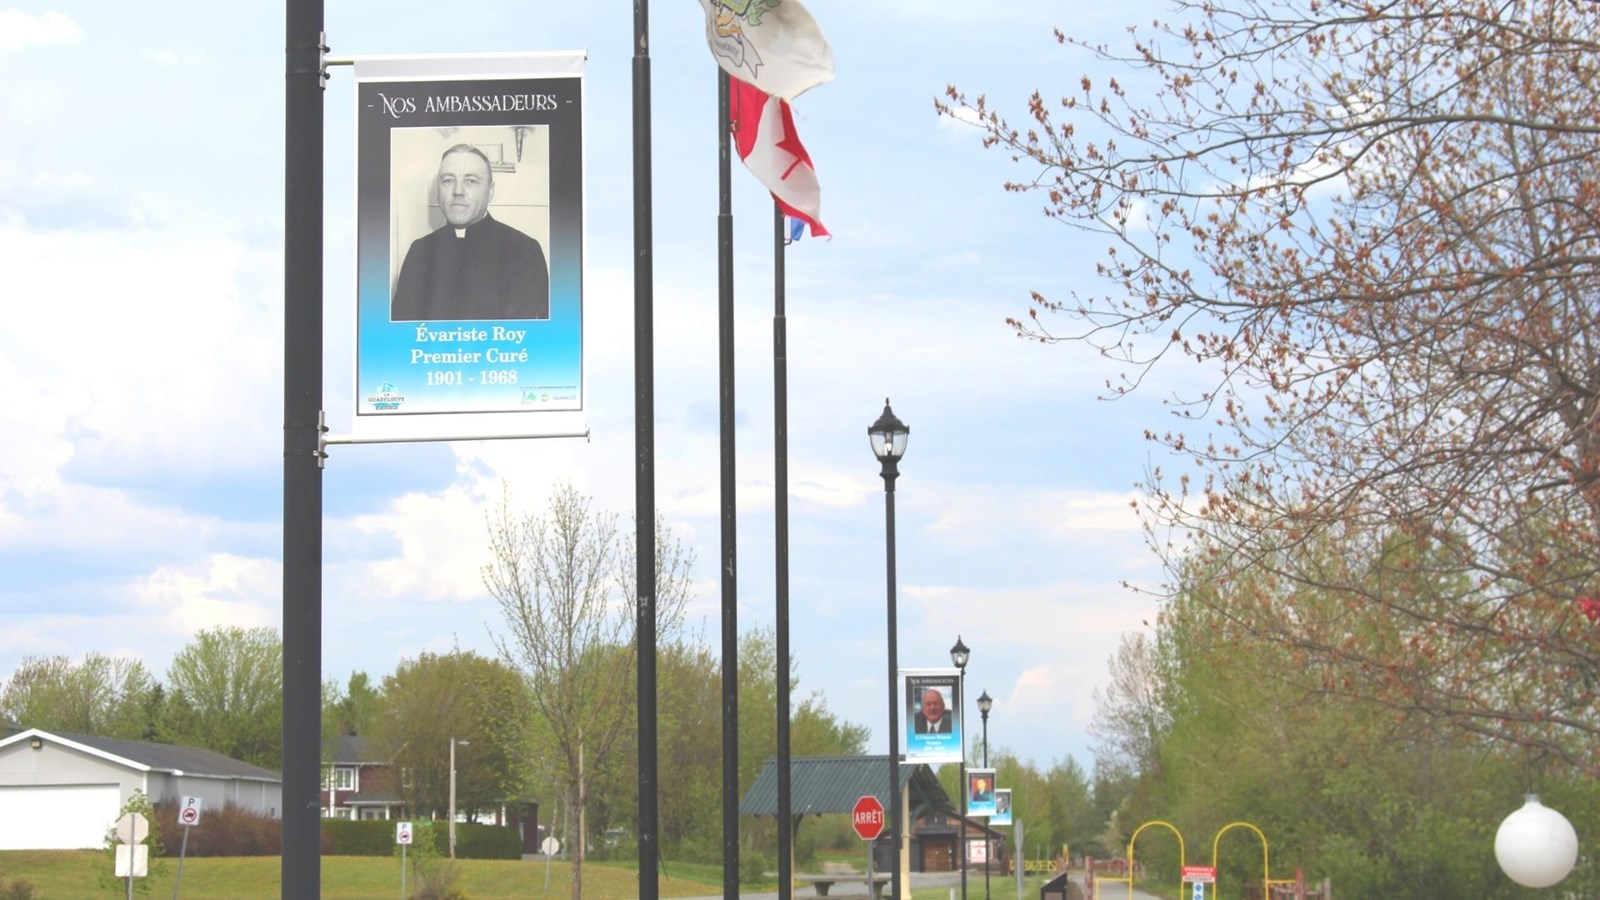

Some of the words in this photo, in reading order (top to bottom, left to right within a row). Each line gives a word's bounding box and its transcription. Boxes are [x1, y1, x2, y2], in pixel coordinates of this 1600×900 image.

[377, 92, 416, 119] NOS
[425, 94, 558, 112] AMBASSADEURS
[416, 323, 488, 342] Évariste
[492, 326, 527, 344] Roy
[411, 348, 481, 364] Premier
[485, 348, 528, 363] Curé
[426, 371, 463, 385] 1901
[480, 370, 518, 385] 1968
[855, 809, 882, 825] ARRÊT
